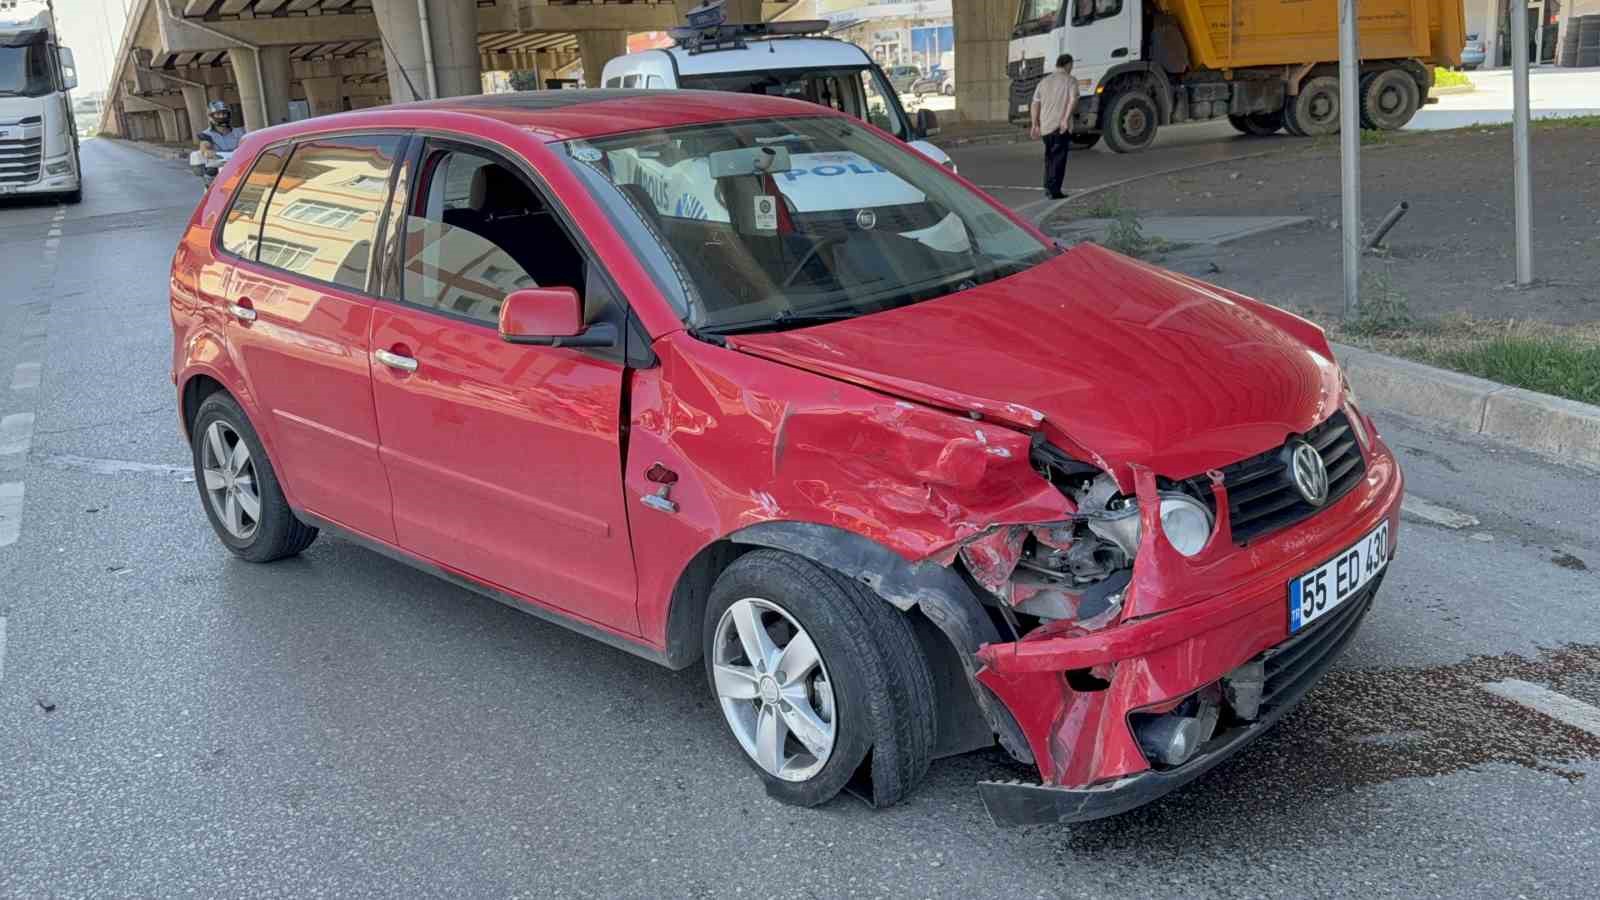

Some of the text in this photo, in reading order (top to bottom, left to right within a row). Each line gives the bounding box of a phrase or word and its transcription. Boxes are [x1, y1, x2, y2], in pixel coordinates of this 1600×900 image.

[1302, 526, 1387, 618] 55 ED 430
